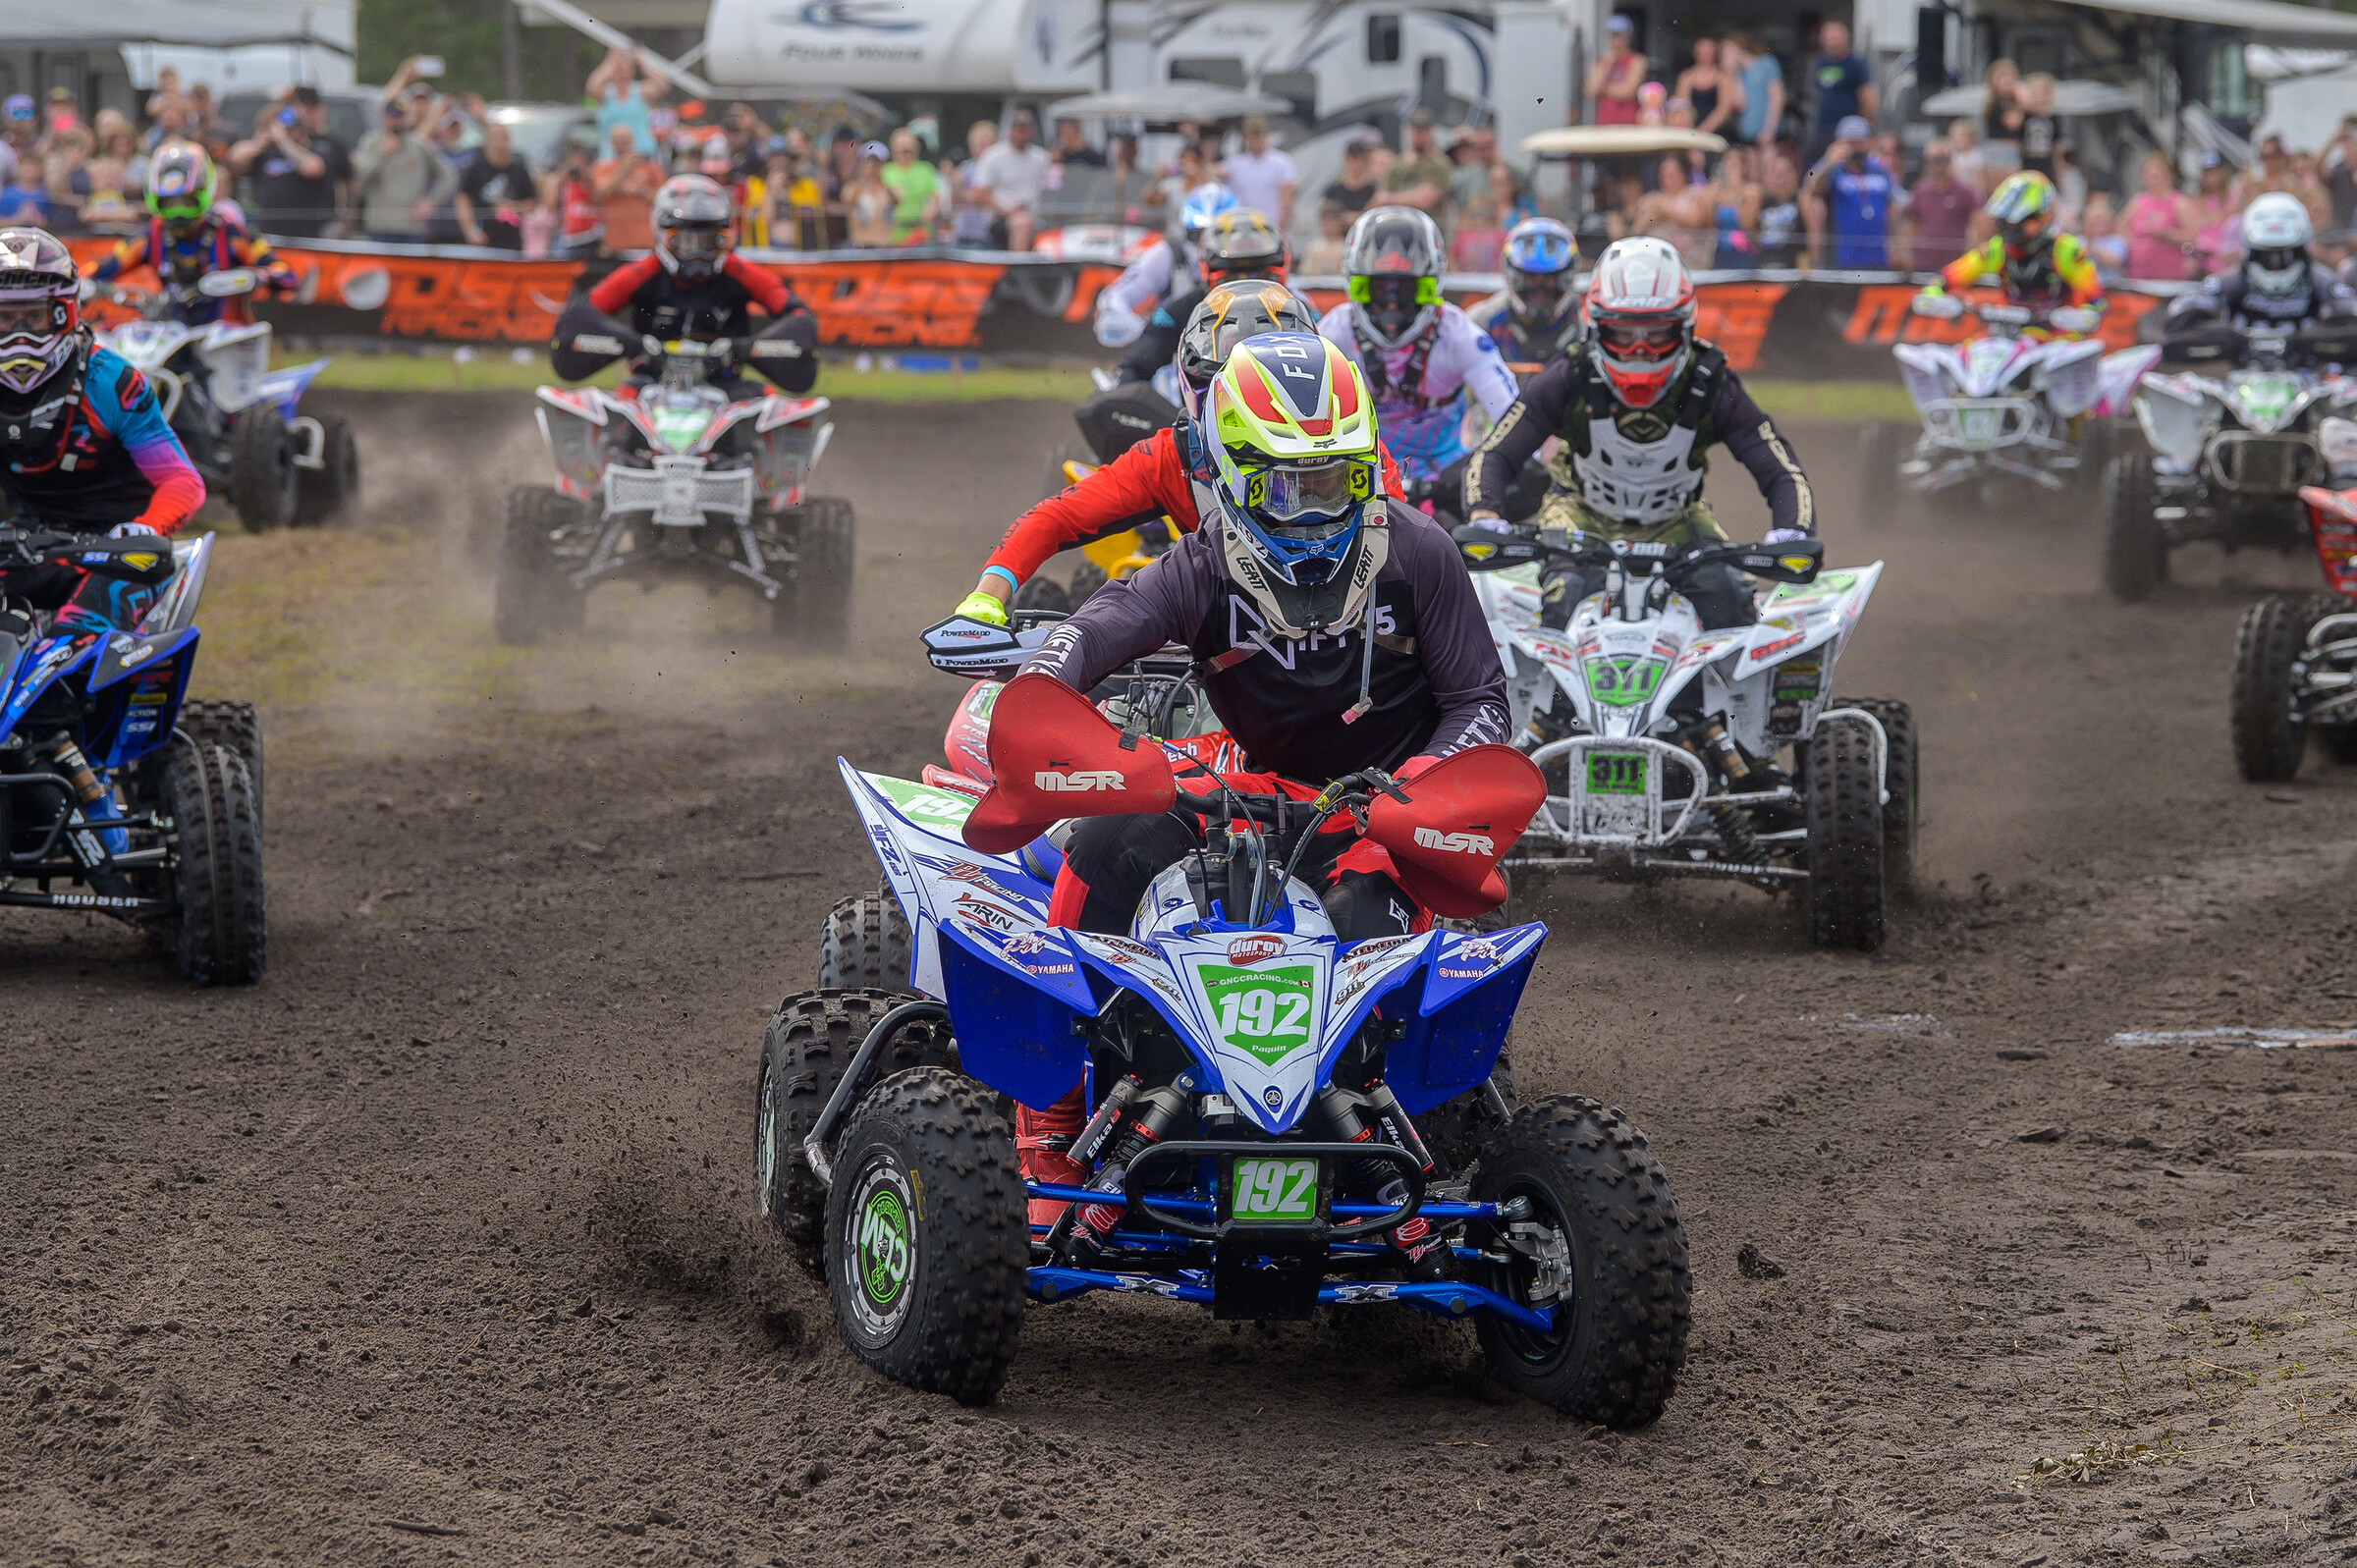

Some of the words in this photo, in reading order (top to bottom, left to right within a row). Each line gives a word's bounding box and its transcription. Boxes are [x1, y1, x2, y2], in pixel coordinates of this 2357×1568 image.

[1266, 335, 1316, 381] FOX
[1034, 770, 1127, 792] MSR
[1592, 757, 1641, 783] 311
[1413, 826, 1495, 857] MSR
[1229, 939, 1286, 956] duroy
[1038, 963, 1074, 975] YAMAHA
[1220, 973, 1299, 986] GNCCRACING.COM
[1449, 968, 1485, 979] YAMAHA
[1218, 988, 1311, 1038] 192
[1251, 1045, 1287, 1054] Paquin
[1085, 1122, 1114, 1160] Elka
[1233, 1160, 1316, 1214] 192
